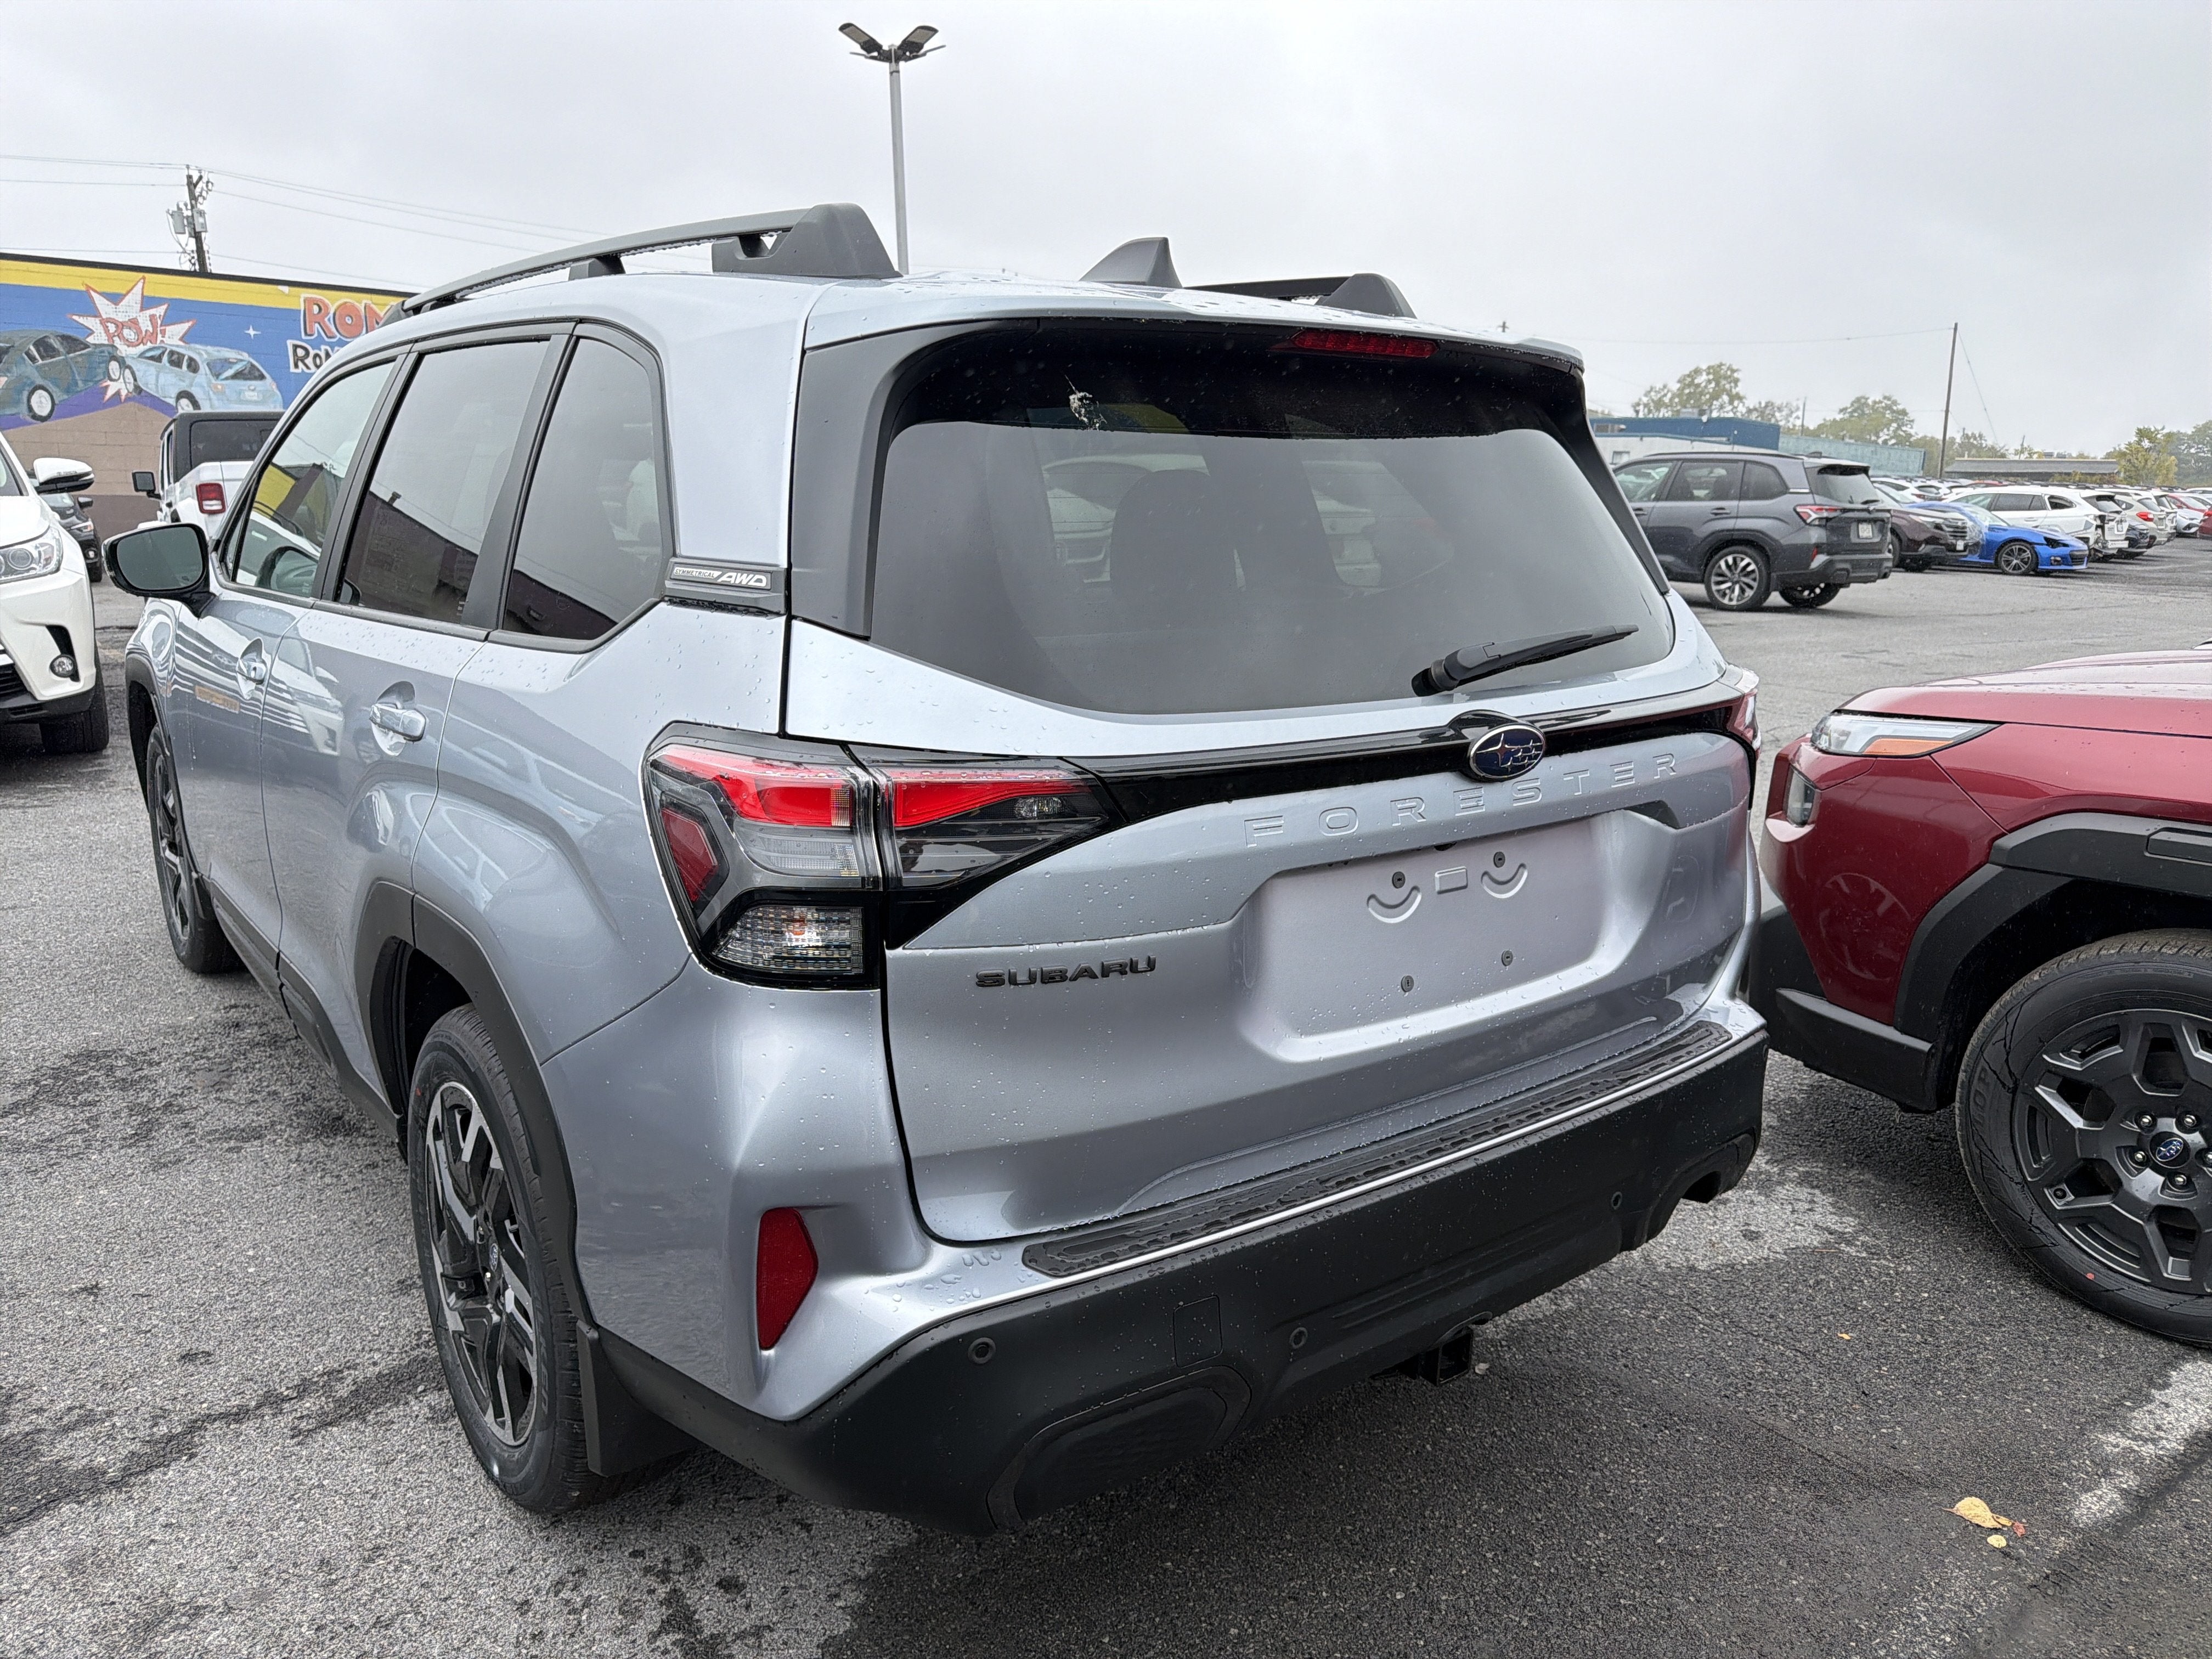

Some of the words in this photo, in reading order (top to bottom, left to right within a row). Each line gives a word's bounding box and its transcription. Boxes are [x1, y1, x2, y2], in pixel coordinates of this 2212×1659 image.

[675, 568, 715, 578] SYMMETRICAL
[717, 572, 767, 586] AWD
[1244, 753, 1676, 848] FORESTER
[975, 955, 1156, 987] SUBARU
